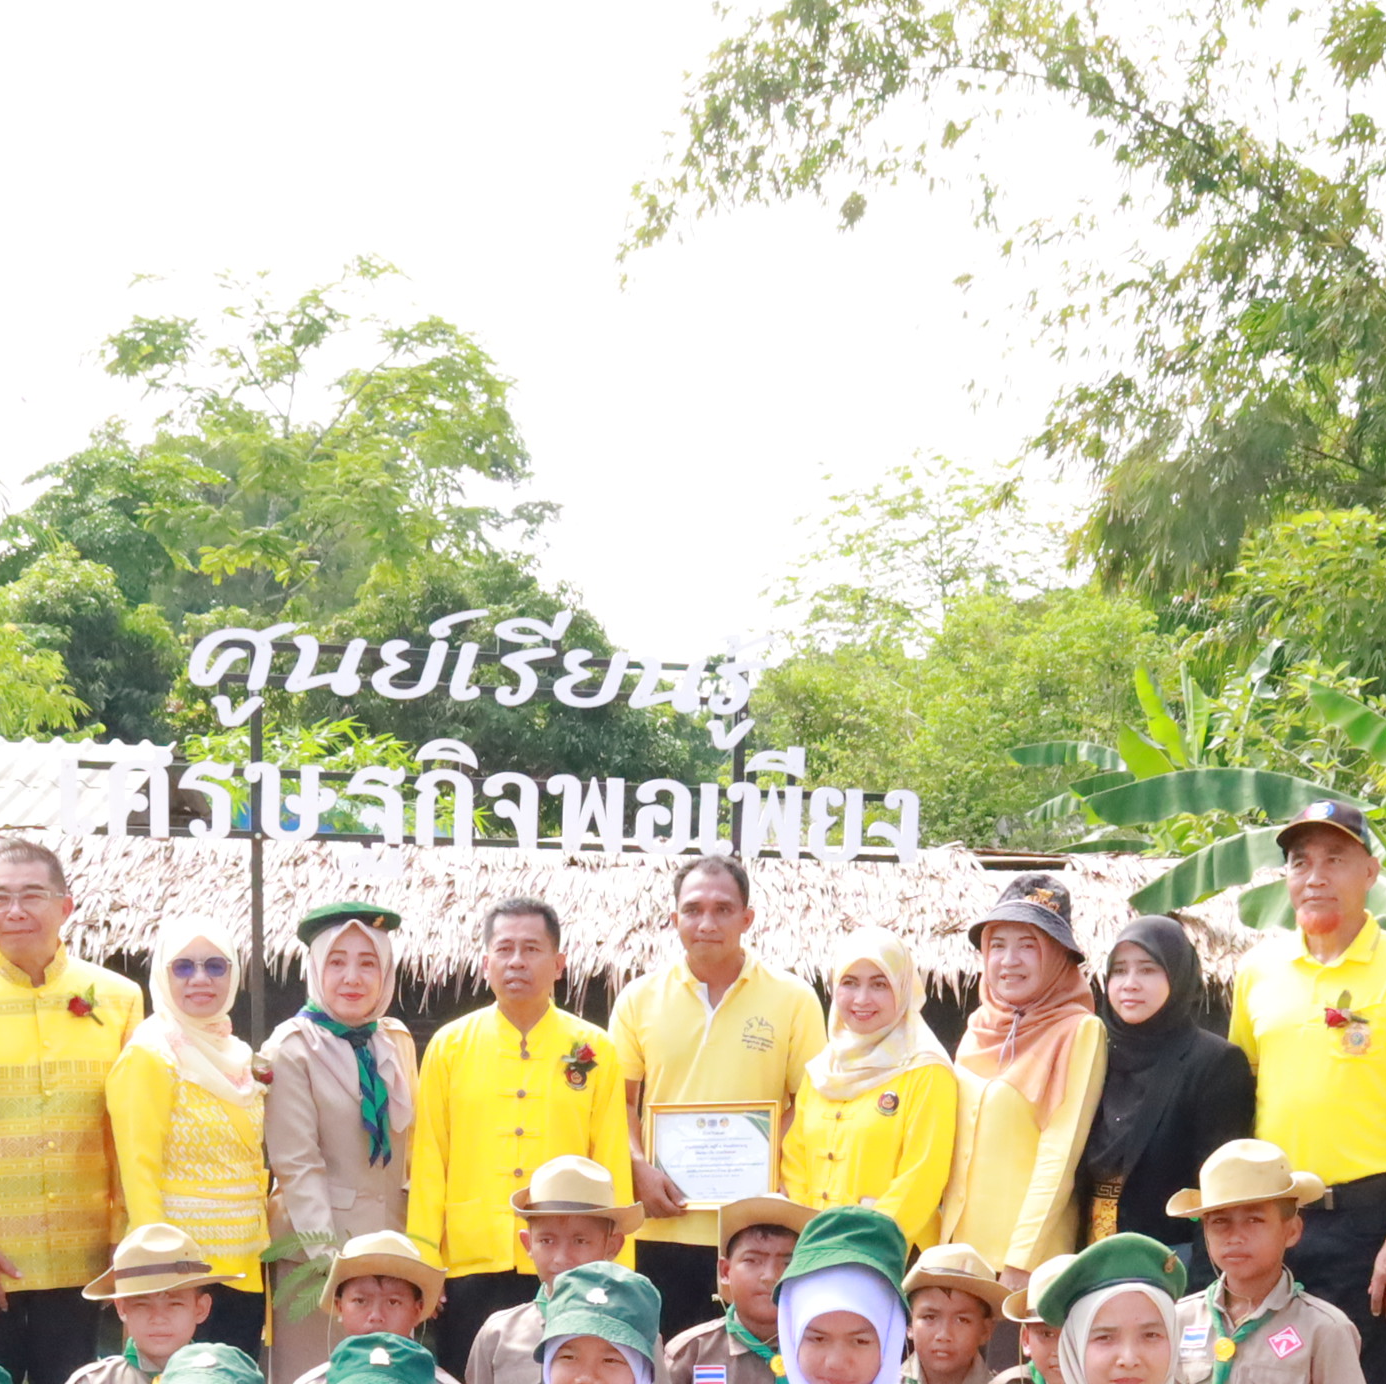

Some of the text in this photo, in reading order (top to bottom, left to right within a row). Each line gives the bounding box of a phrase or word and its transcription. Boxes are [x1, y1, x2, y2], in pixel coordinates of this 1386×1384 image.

[188, 608, 775, 750] ศูนย์เรียนรู้
[62, 738, 920, 878] เศรษฐกิจพอเพียง
